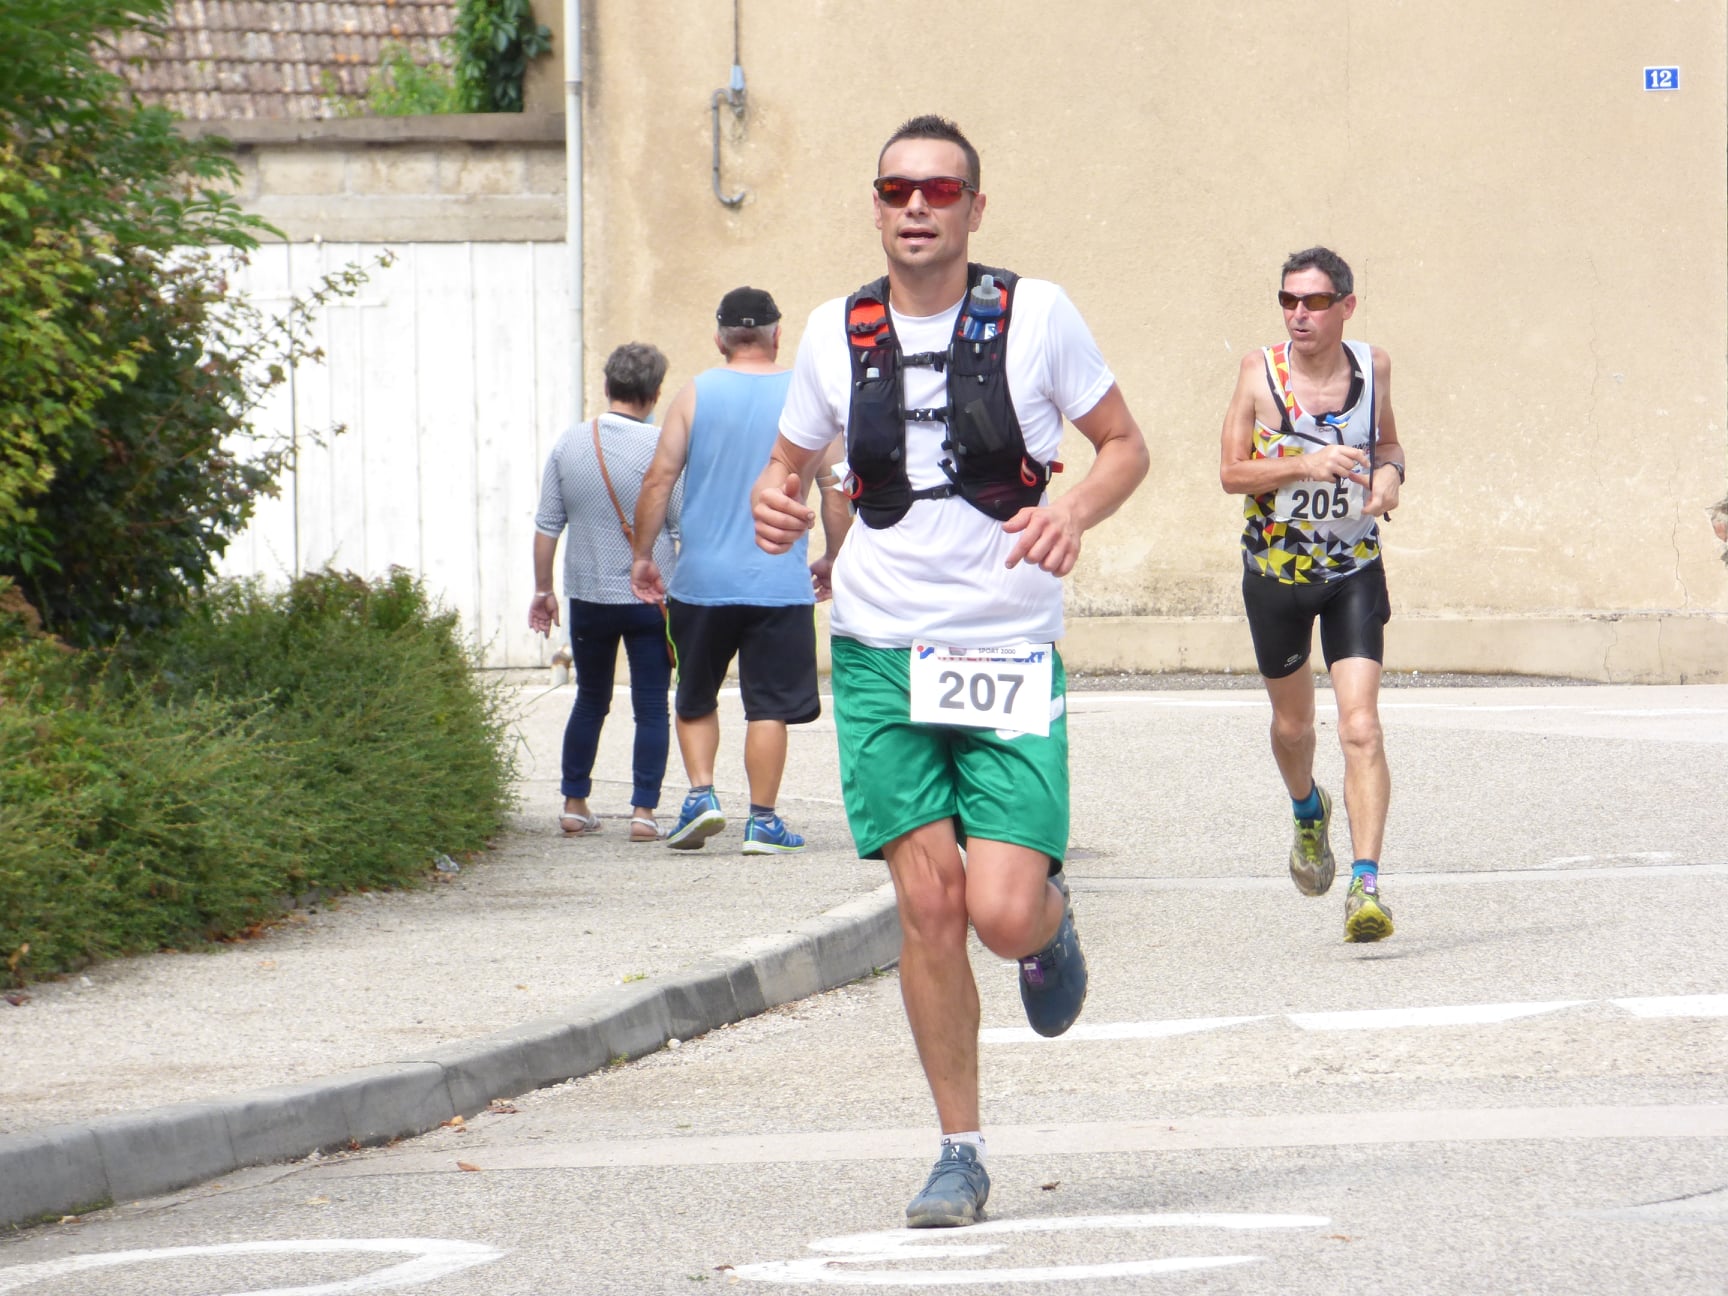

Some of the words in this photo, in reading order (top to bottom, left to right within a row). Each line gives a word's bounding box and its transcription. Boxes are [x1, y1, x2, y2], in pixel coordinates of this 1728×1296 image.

[1651, 70, 1672, 87] 12
[1291, 488, 1349, 519] 205
[938, 670, 1025, 715] 207
